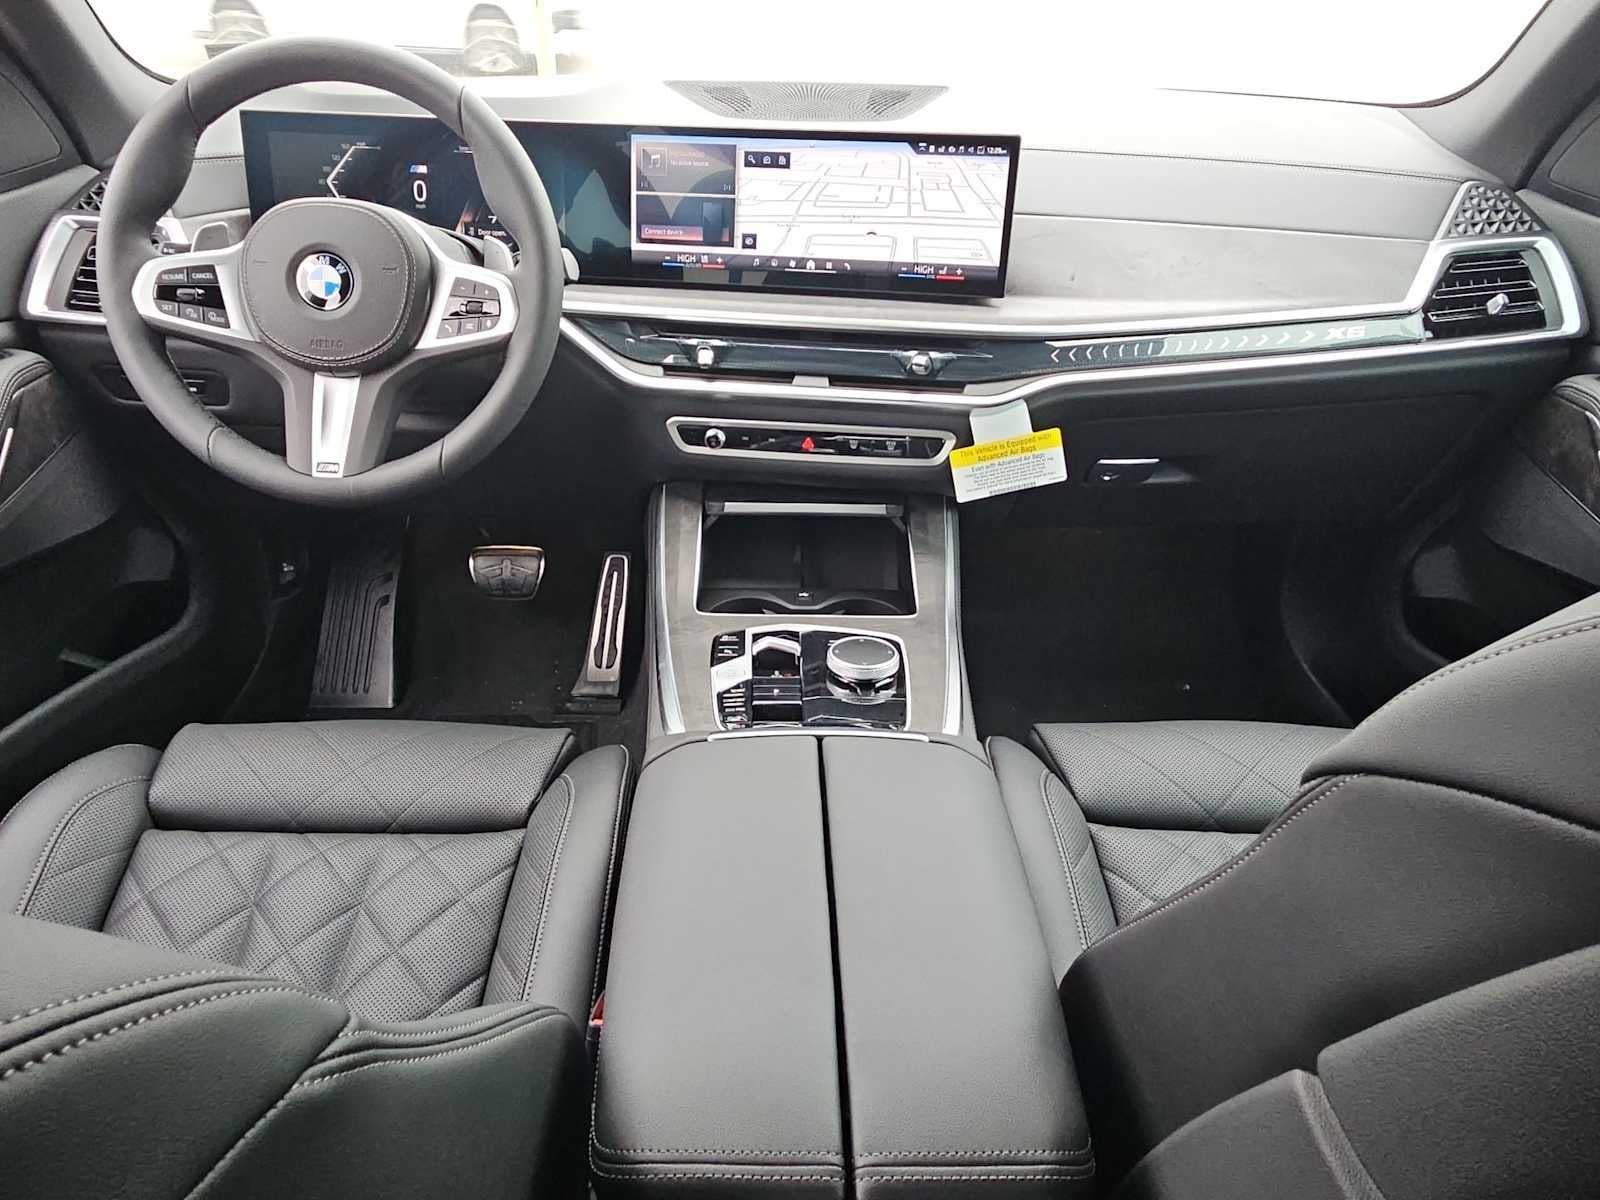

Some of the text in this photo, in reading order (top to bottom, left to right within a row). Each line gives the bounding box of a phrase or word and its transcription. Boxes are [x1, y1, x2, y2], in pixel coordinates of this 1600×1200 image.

[413, 180, 427, 202] 0
[478, 228, 491, 236] Door
[677, 253, 696, 263] HIGH
[914, 264, 935, 274] HIGH
[1326, 325, 1366, 340] X6
[960, 449, 974, 458] This
[976, 444, 998, 454] Vehicle
[1006, 436, 1036, 448] Equipped
[977, 450, 1008, 462] Advanced
[1021, 445, 1037, 455] Bags
[971, 464, 984, 473] Even
[998, 456, 1022, 467] Advanced
